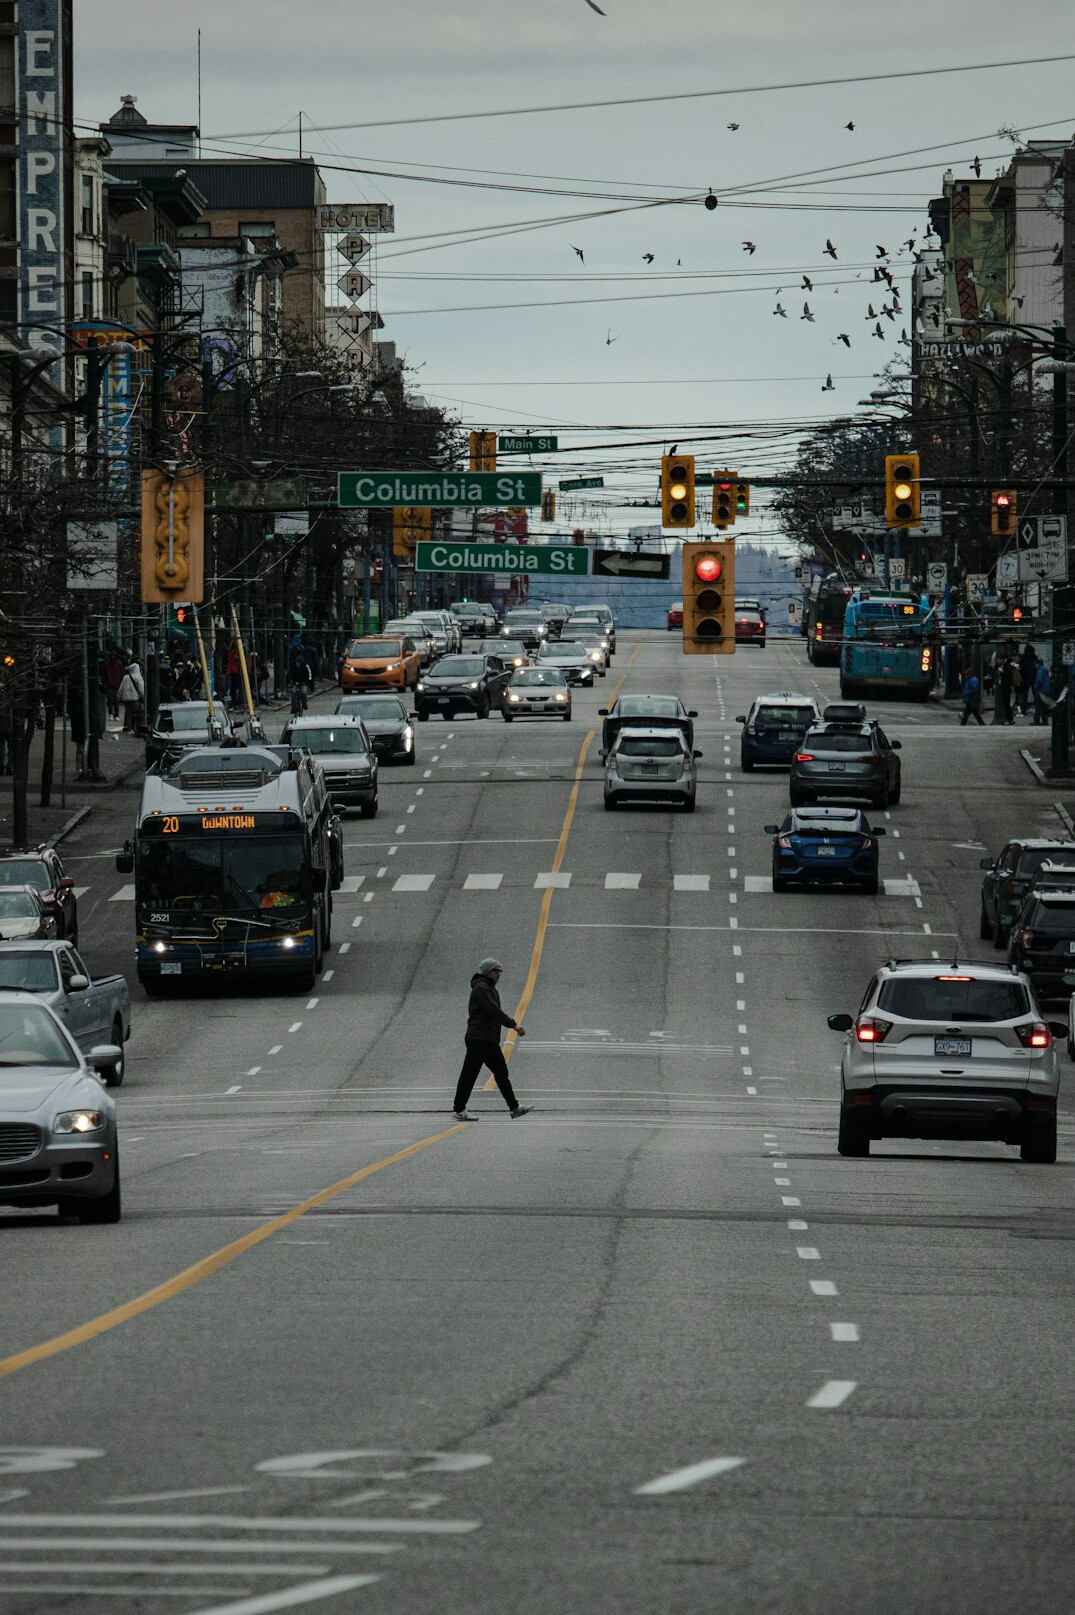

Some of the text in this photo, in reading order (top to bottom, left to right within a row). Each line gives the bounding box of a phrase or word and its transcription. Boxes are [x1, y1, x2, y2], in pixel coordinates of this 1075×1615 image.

[320, 210, 393, 229] HOTEL
[504, 438, 552, 449] Main St
[355, 477, 526, 501] Columbia St
[430, 547, 575, 571] Columbia St
[891, 564, 903, 574] 30
[971, 582, 985, 595] 30
[162, 815, 255, 833] 20 DOWNTOWN
[150, 913, 170, 923] 2521
